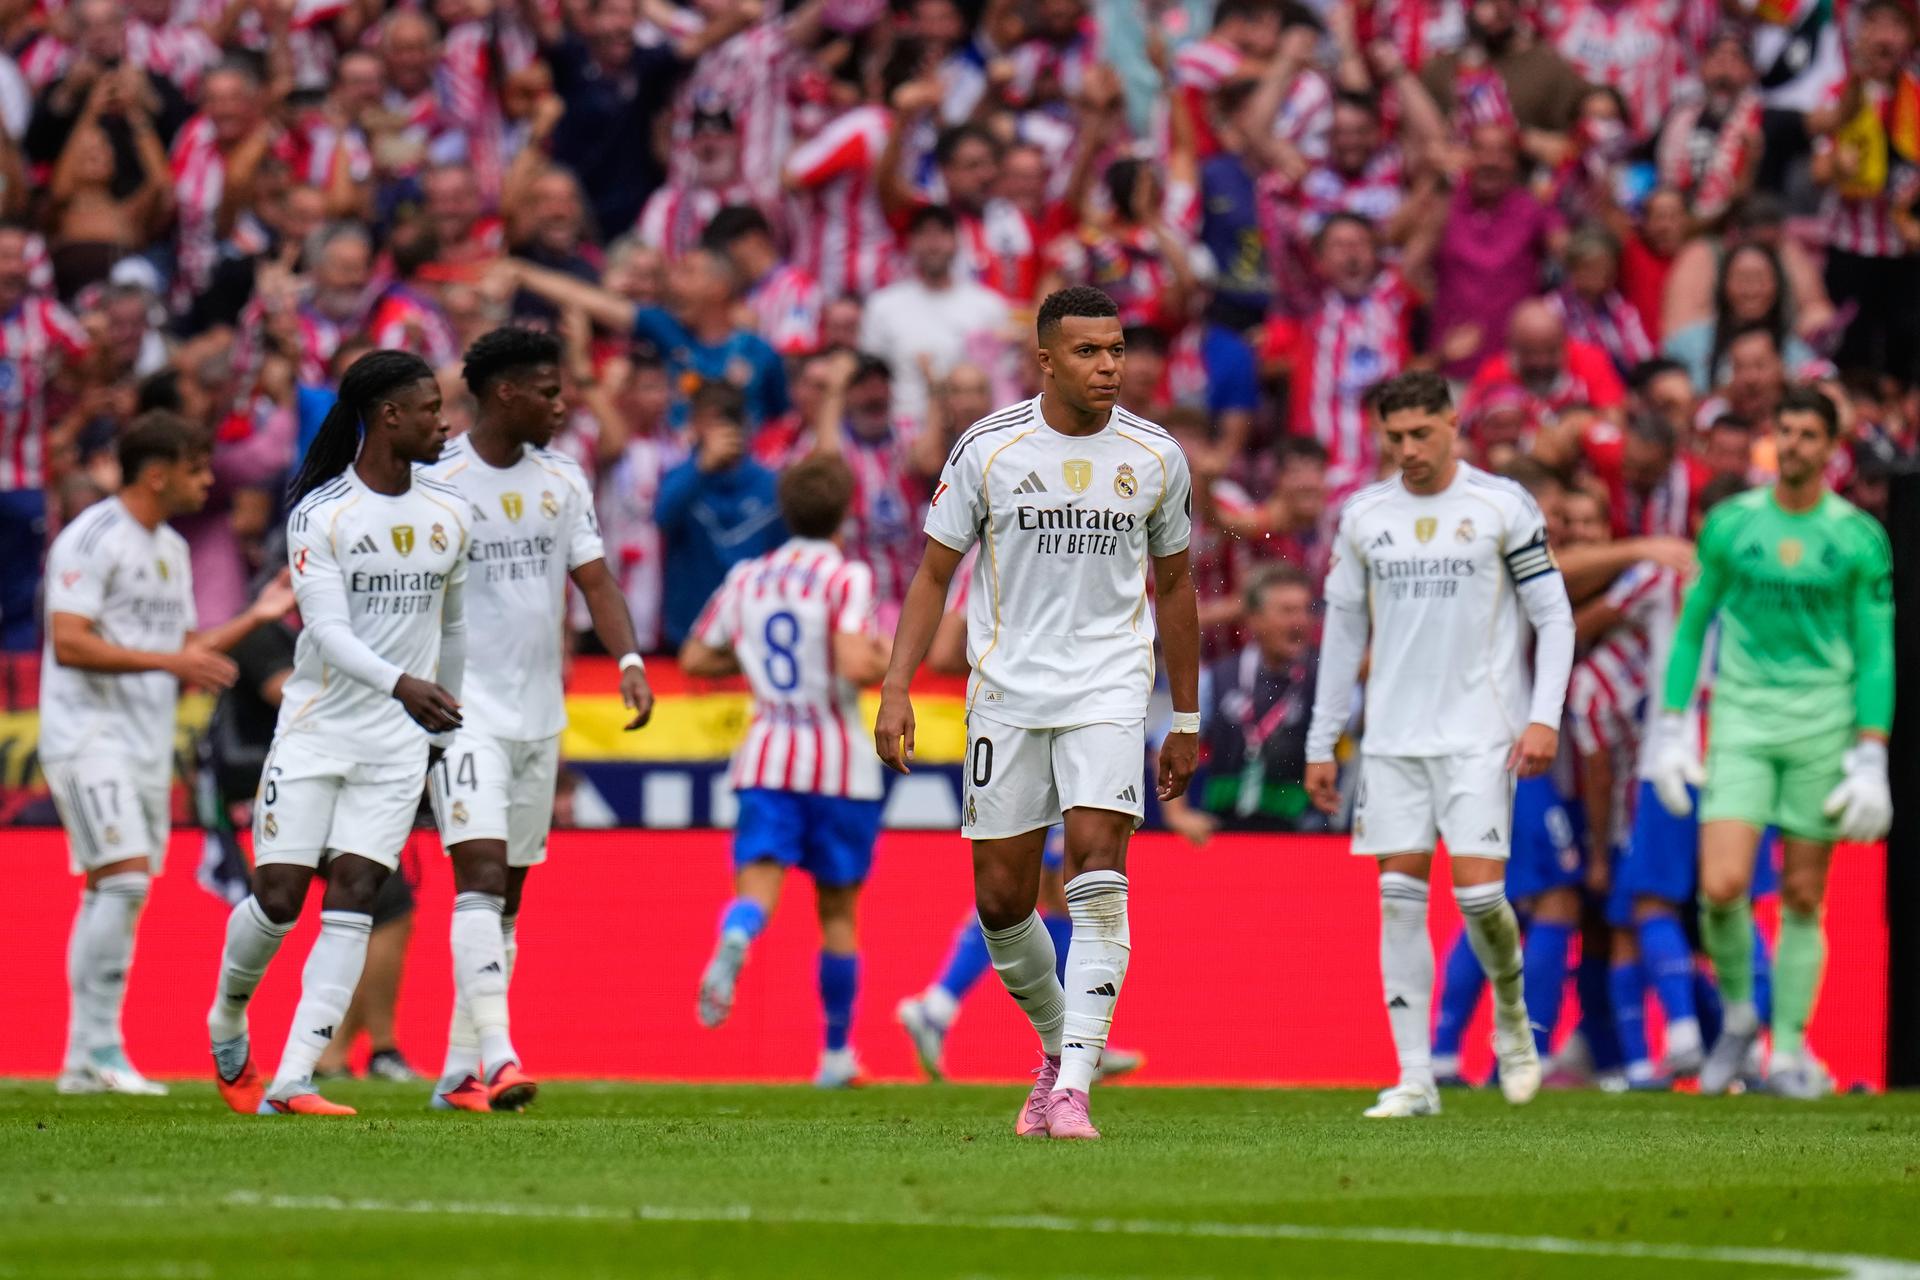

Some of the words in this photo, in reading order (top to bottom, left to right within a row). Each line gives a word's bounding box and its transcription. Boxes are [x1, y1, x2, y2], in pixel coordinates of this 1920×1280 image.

[1017, 503, 1137, 533] Emirates
[467, 535, 557, 562] Emirate
[1037, 534, 1062, 555] FLY
[1067, 534, 1118, 556] BETTER
[1373, 556, 1476, 581] Emirates
[764, 611, 799, 691] 8
[265, 766, 284, 807] 6
[440, 752, 478, 797] 14
[87, 779, 122, 820] 17
